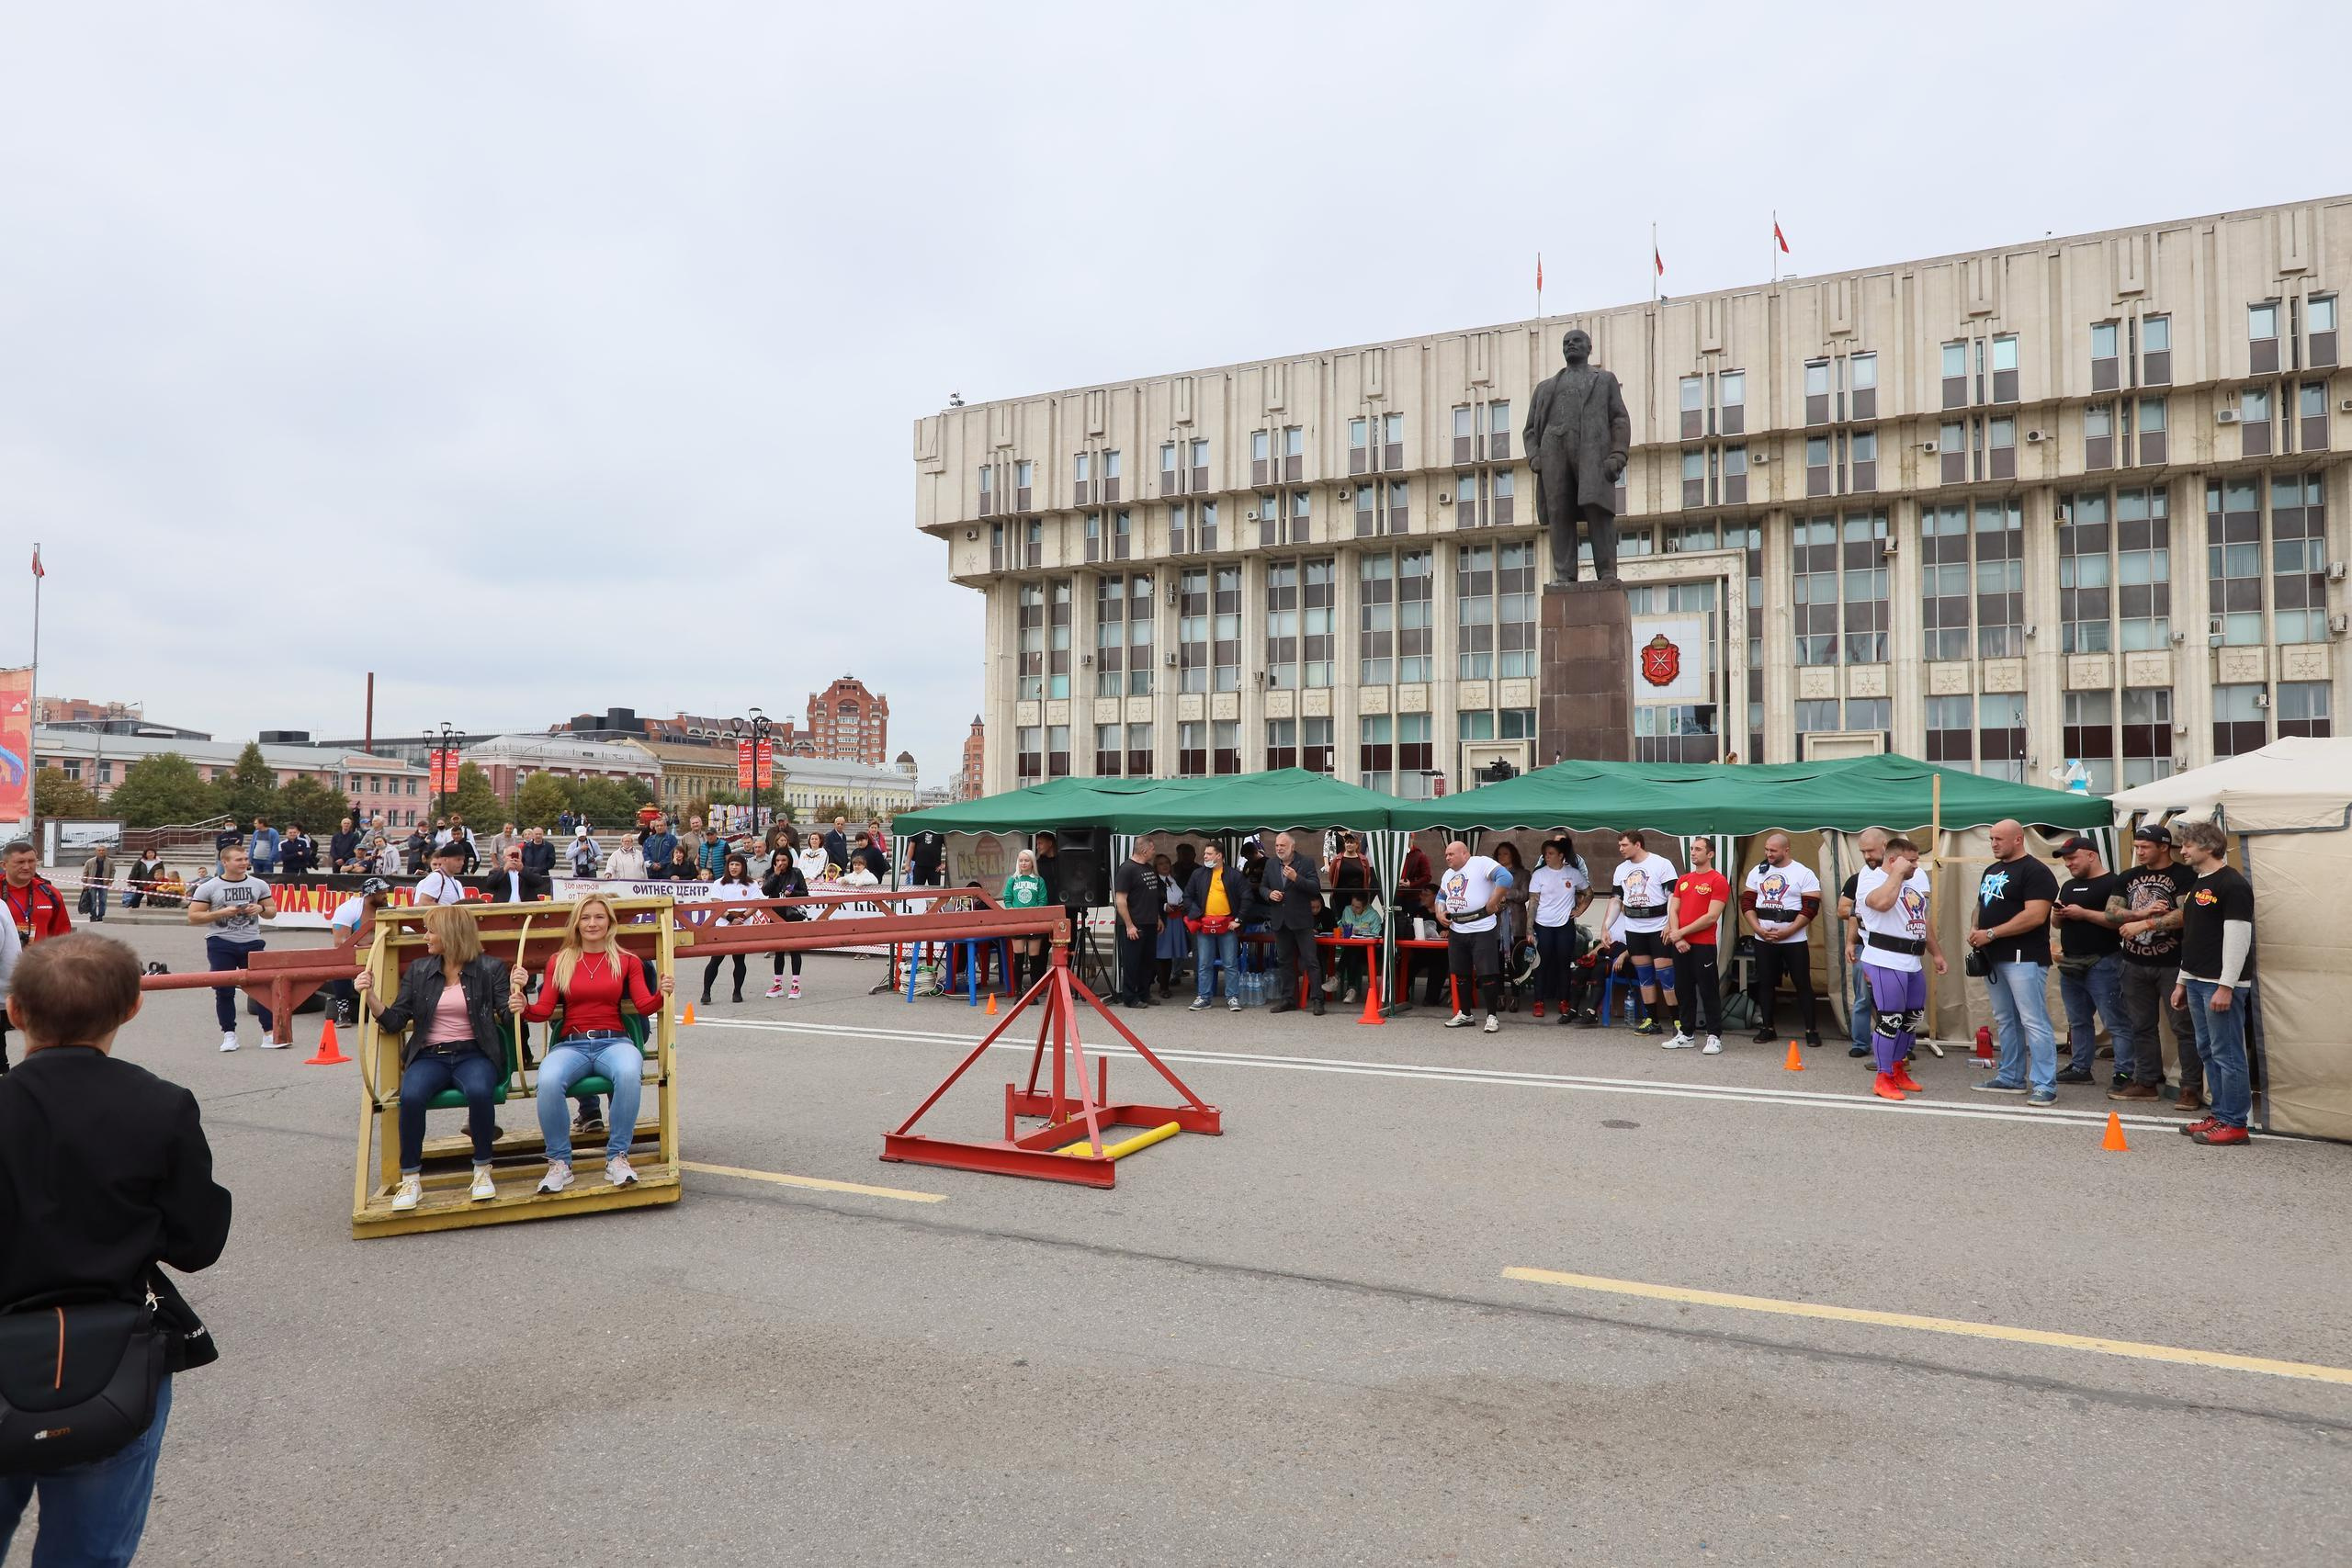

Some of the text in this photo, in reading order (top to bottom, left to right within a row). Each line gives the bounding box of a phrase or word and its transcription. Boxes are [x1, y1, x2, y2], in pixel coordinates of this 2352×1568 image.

[270, 883, 311, 912] ИЛА
[632, 885, 709, 897] ФИТНЕС ЦЕНТР
[2125, 936, 2177, 956] ELIGION
